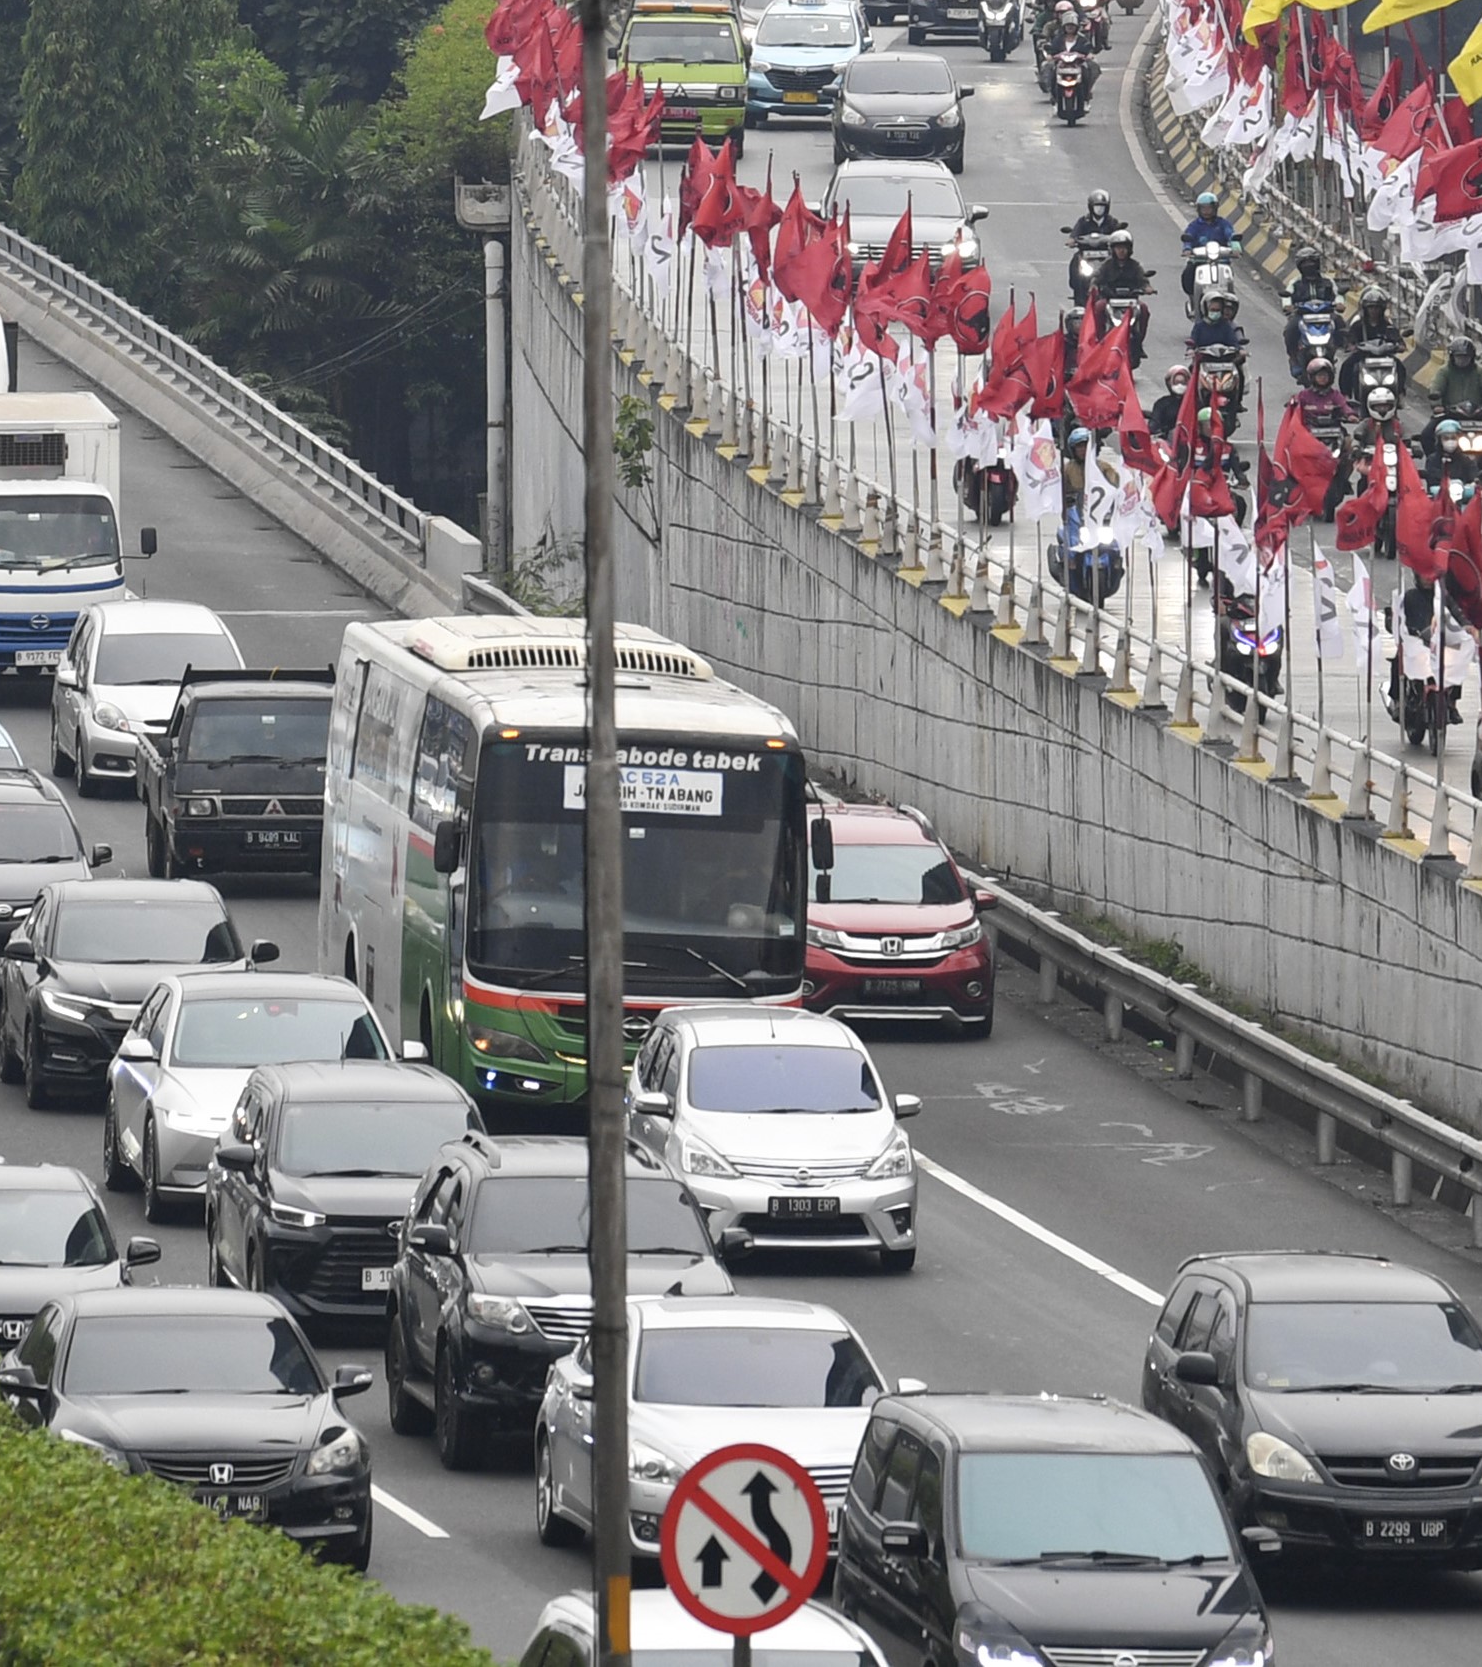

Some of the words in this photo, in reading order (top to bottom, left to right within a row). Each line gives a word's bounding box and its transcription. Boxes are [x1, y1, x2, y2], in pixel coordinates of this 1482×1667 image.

[17, 651, 23, 661] B
[692, 749, 762, 772] tabek
[646, 787, 665, 801] TN
[668, 788, 713, 803] ABANG
[772, 1199, 779, 1211] B
[788, 1199, 811, 1212] 1303
[817, 1199, 837, 1212] ERP
[365, 1270, 372, 1283] B
[1366, 1521, 1374, 1536] B
[1380, 1522, 1411, 1536] 2299
